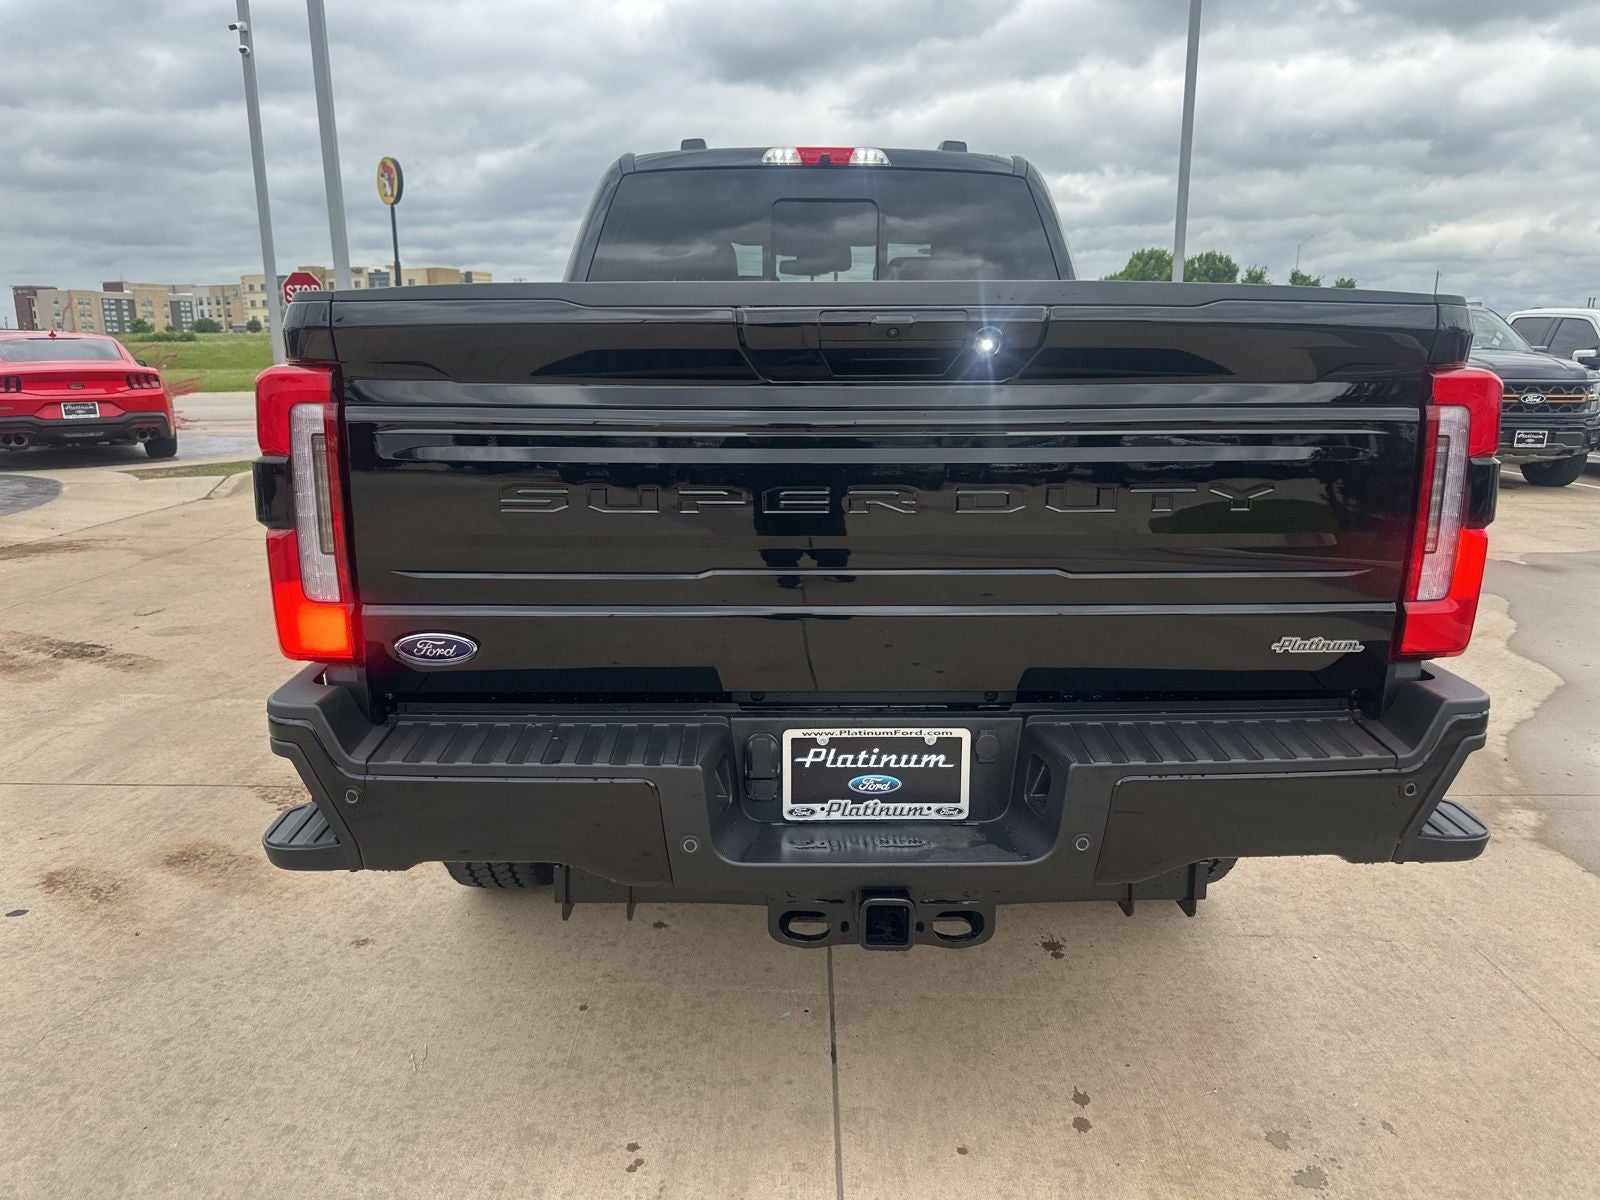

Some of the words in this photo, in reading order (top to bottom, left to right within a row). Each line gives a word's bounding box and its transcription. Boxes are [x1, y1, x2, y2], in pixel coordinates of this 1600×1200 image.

[1524, 395, 1542, 403] Ford
[499, 482, 917, 514] SUPER
[955, 482, 1275, 514] DUTY
[413, 640, 457, 657] Ford
[1271, 636, 1365, 653] Platinum
[802, 729, 953, 737] www.PlatinumFord.com
[793, 747, 955, 768] Platinum
[858, 777, 891, 791] Ford
[792, 808, 812, 817] Ford
[826, 801, 932, 817] Platinum
